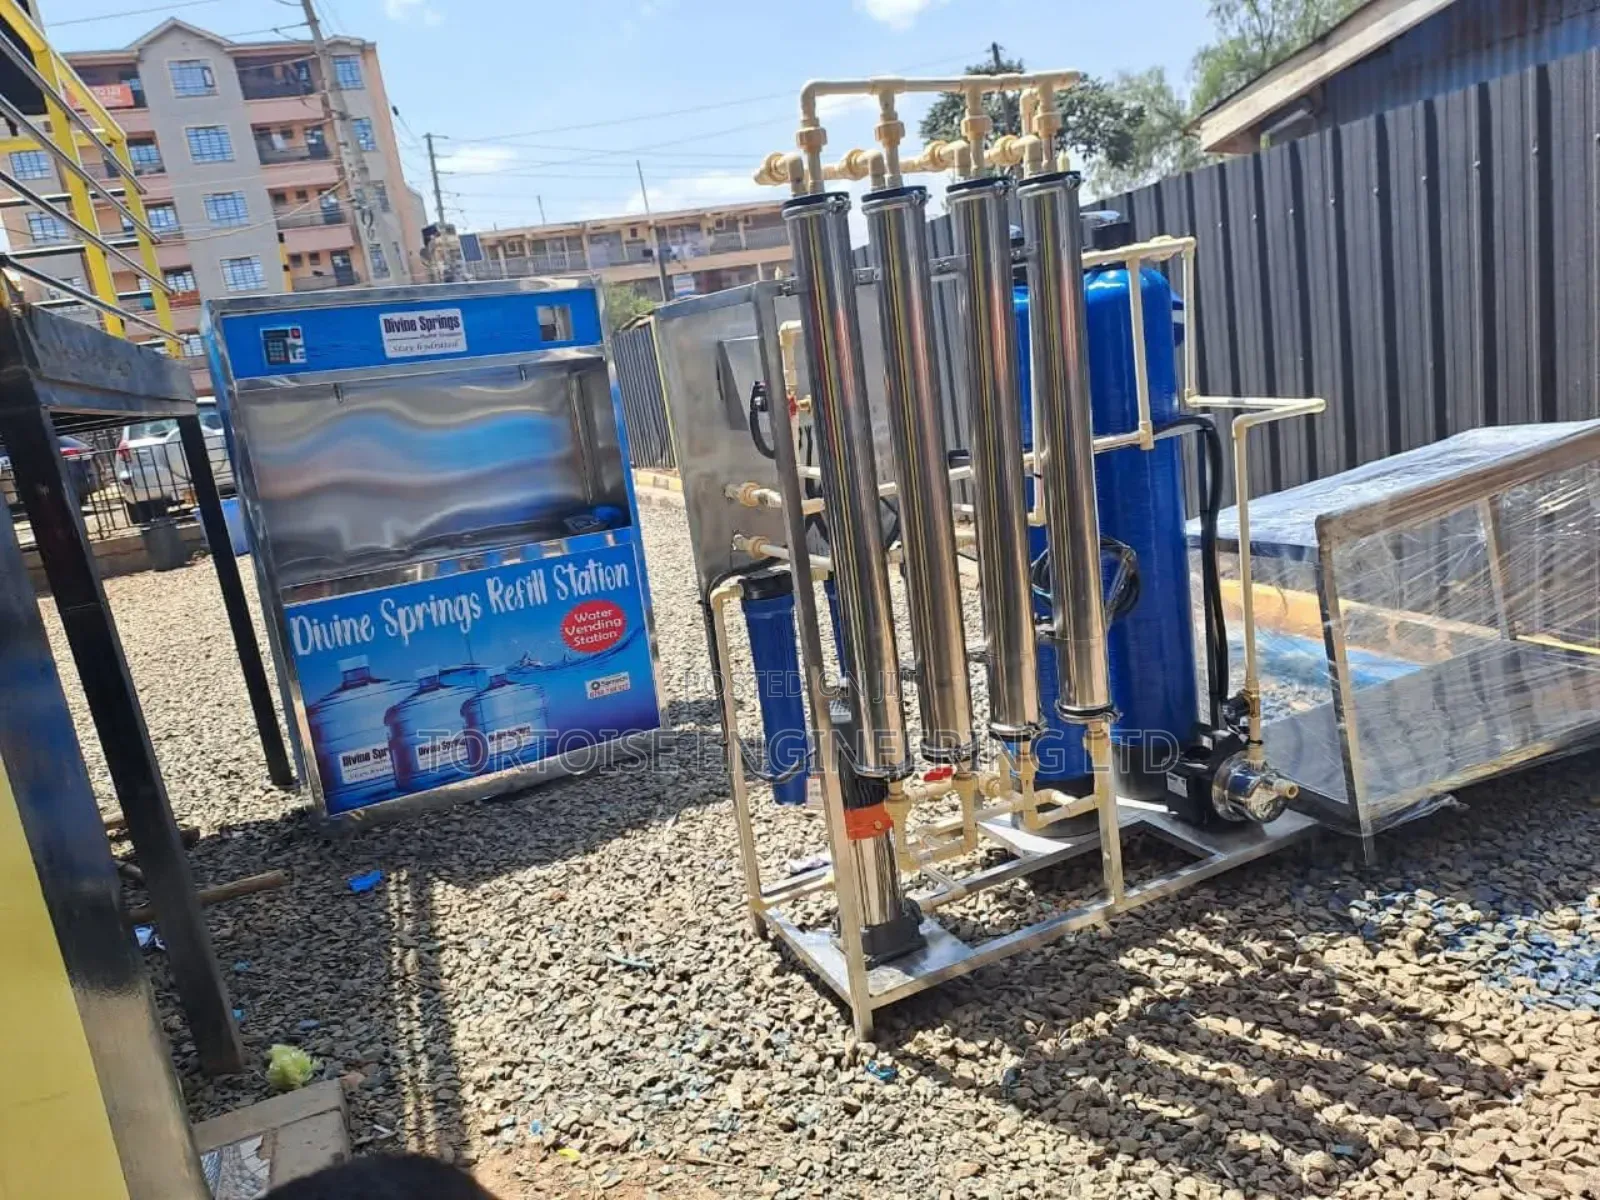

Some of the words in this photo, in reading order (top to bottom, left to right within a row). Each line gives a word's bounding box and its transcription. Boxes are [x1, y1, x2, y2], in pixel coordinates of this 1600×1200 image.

[383, 317, 417, 333] Divine
[418, 314, 461, 332] Springs
[289, 613, 375, 656] Divine
[380, 591, 482, 646] Springs
[485, 567, 548, 615] Refill
[552, 558, 631, 601] Station
[574, 608, 613, 624] Water
[564, 617, 622, 636] Vending
[573, 630, 618, 647] Station
[342, 752, 371, 767] Divine
